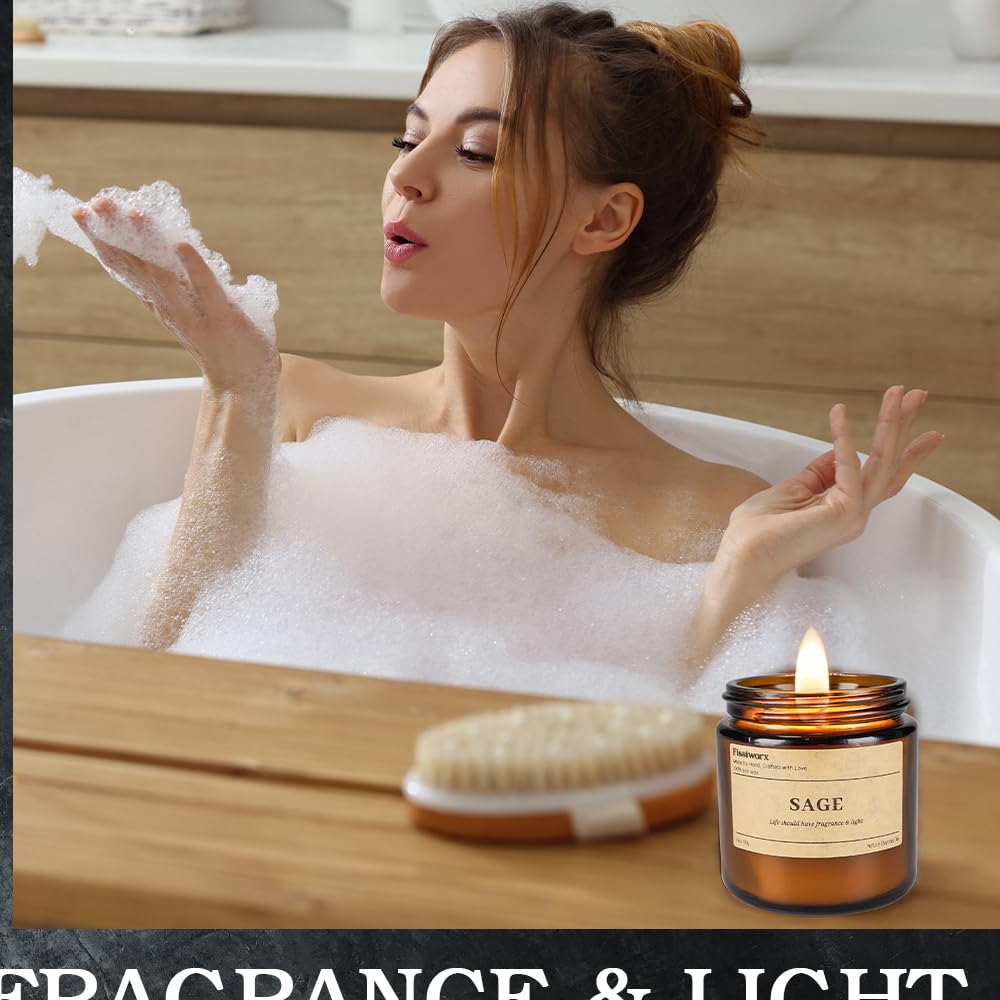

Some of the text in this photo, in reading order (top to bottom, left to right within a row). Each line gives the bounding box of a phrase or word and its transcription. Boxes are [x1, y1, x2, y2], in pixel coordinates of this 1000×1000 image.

[732, 748, 769, 761] Fissiworx
[789, 797, 843, 812] SAGE
[770, 818, 780, 826] Life
[780, 819, 800, 827] should
[814, 820, 844, 828] fragrance
